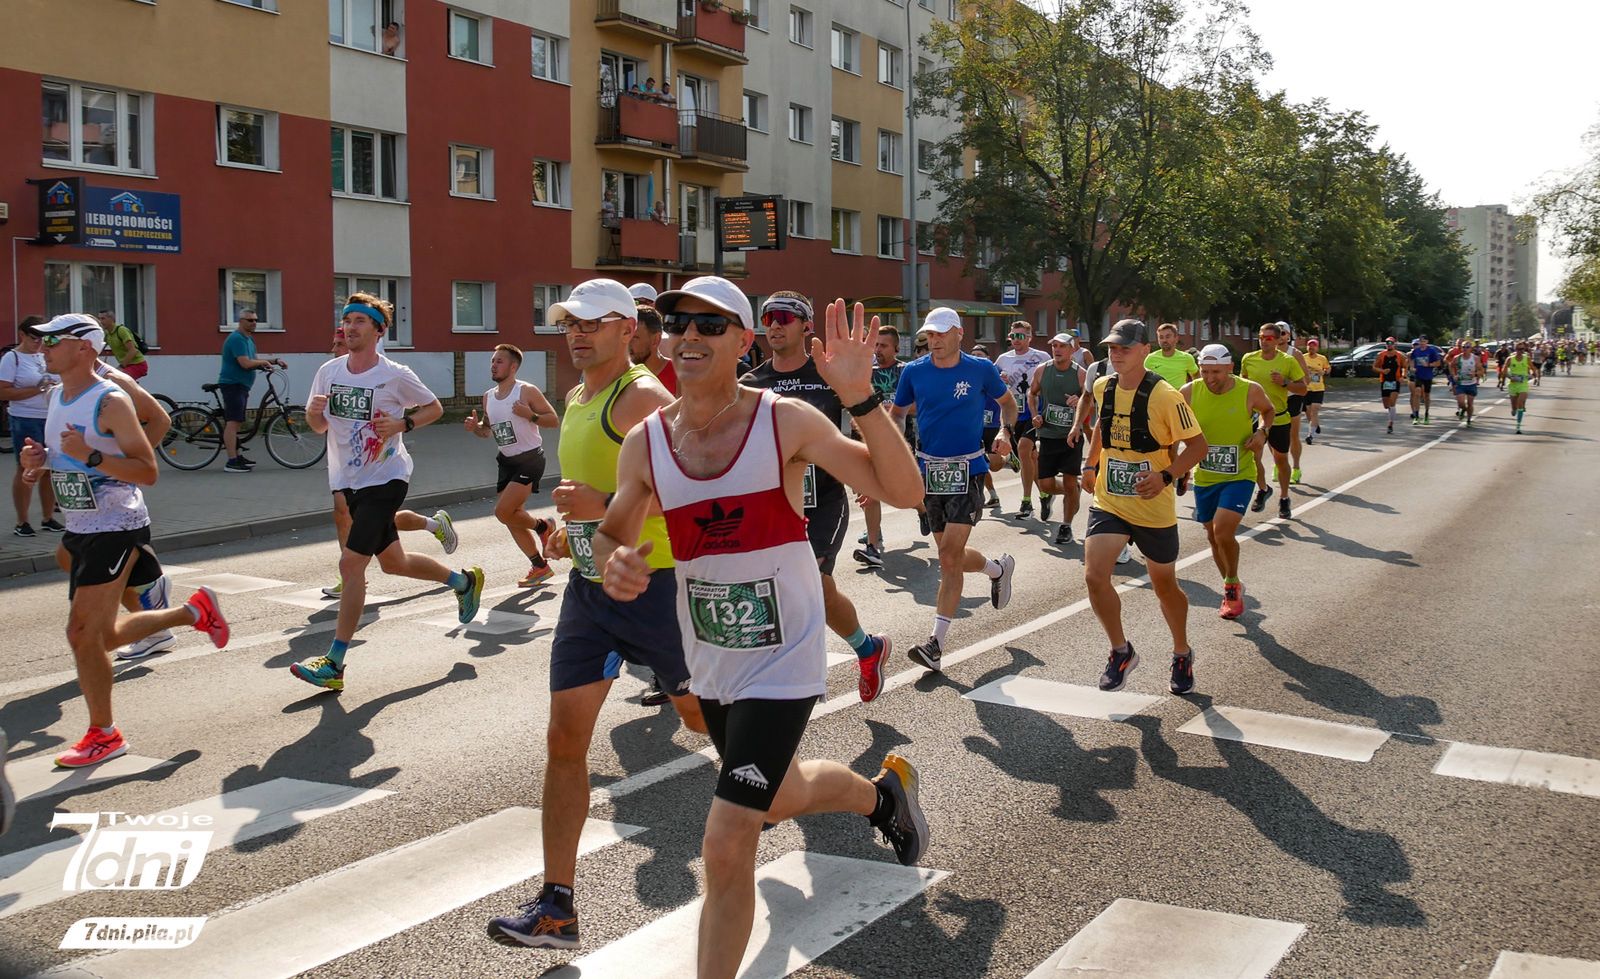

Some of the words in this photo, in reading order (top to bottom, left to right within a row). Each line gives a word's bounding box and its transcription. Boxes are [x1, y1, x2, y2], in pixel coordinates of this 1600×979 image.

[85, 227, 112, 236] REDYTY
[777, 378, 800, 386] TEAM
[335, 394, 367, 409] 1516
[932, 470, 962, 482] 1379
[56, 481, 83, 496] 1037
[573, 536, 593, 557] 88
[706, 600, 756, 626] 132
